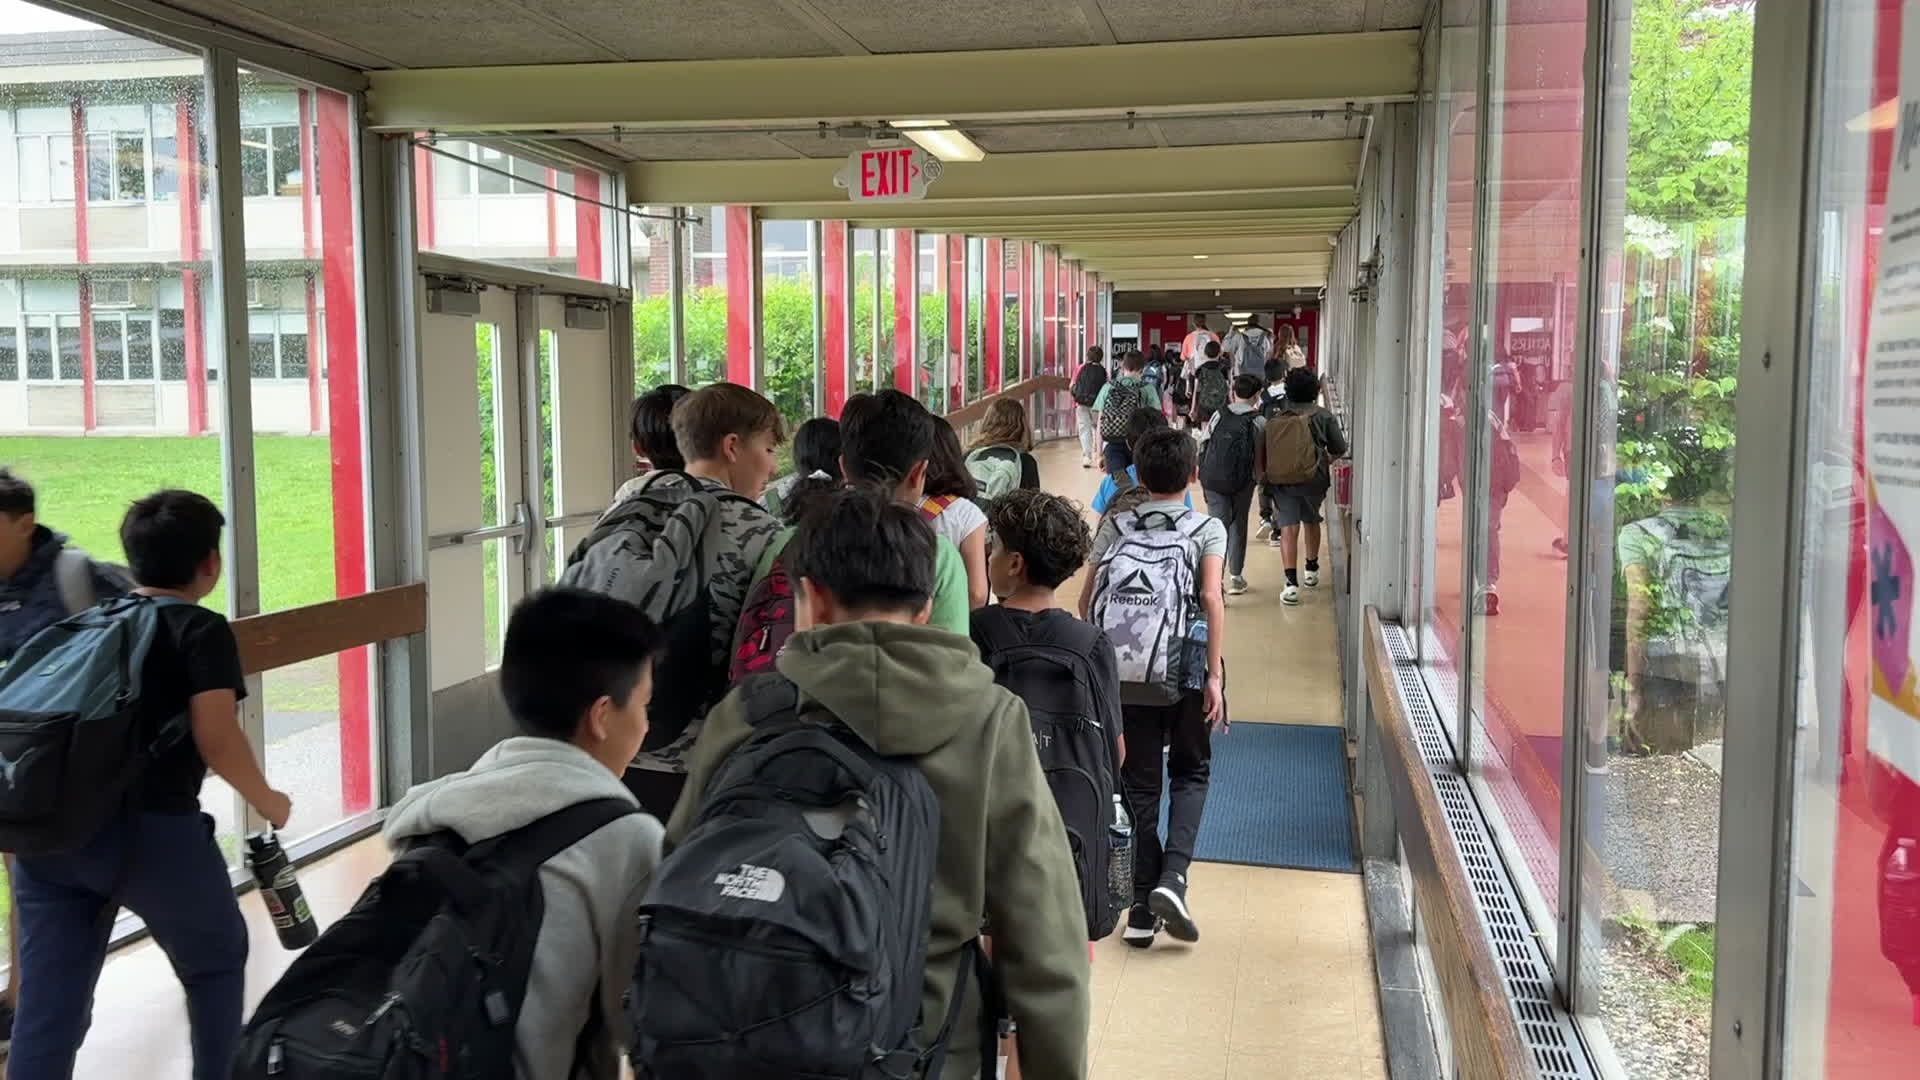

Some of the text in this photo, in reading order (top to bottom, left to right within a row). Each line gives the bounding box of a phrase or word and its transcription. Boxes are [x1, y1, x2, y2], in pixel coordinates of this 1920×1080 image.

[861, 149, 913, 197] EXIT
[1109, 593, 1160, 606] Reebok
[713, 872, 761, 890] NORTH
[740, 863, 769, 881] THE
[719, 885, 759, 898] FACE
